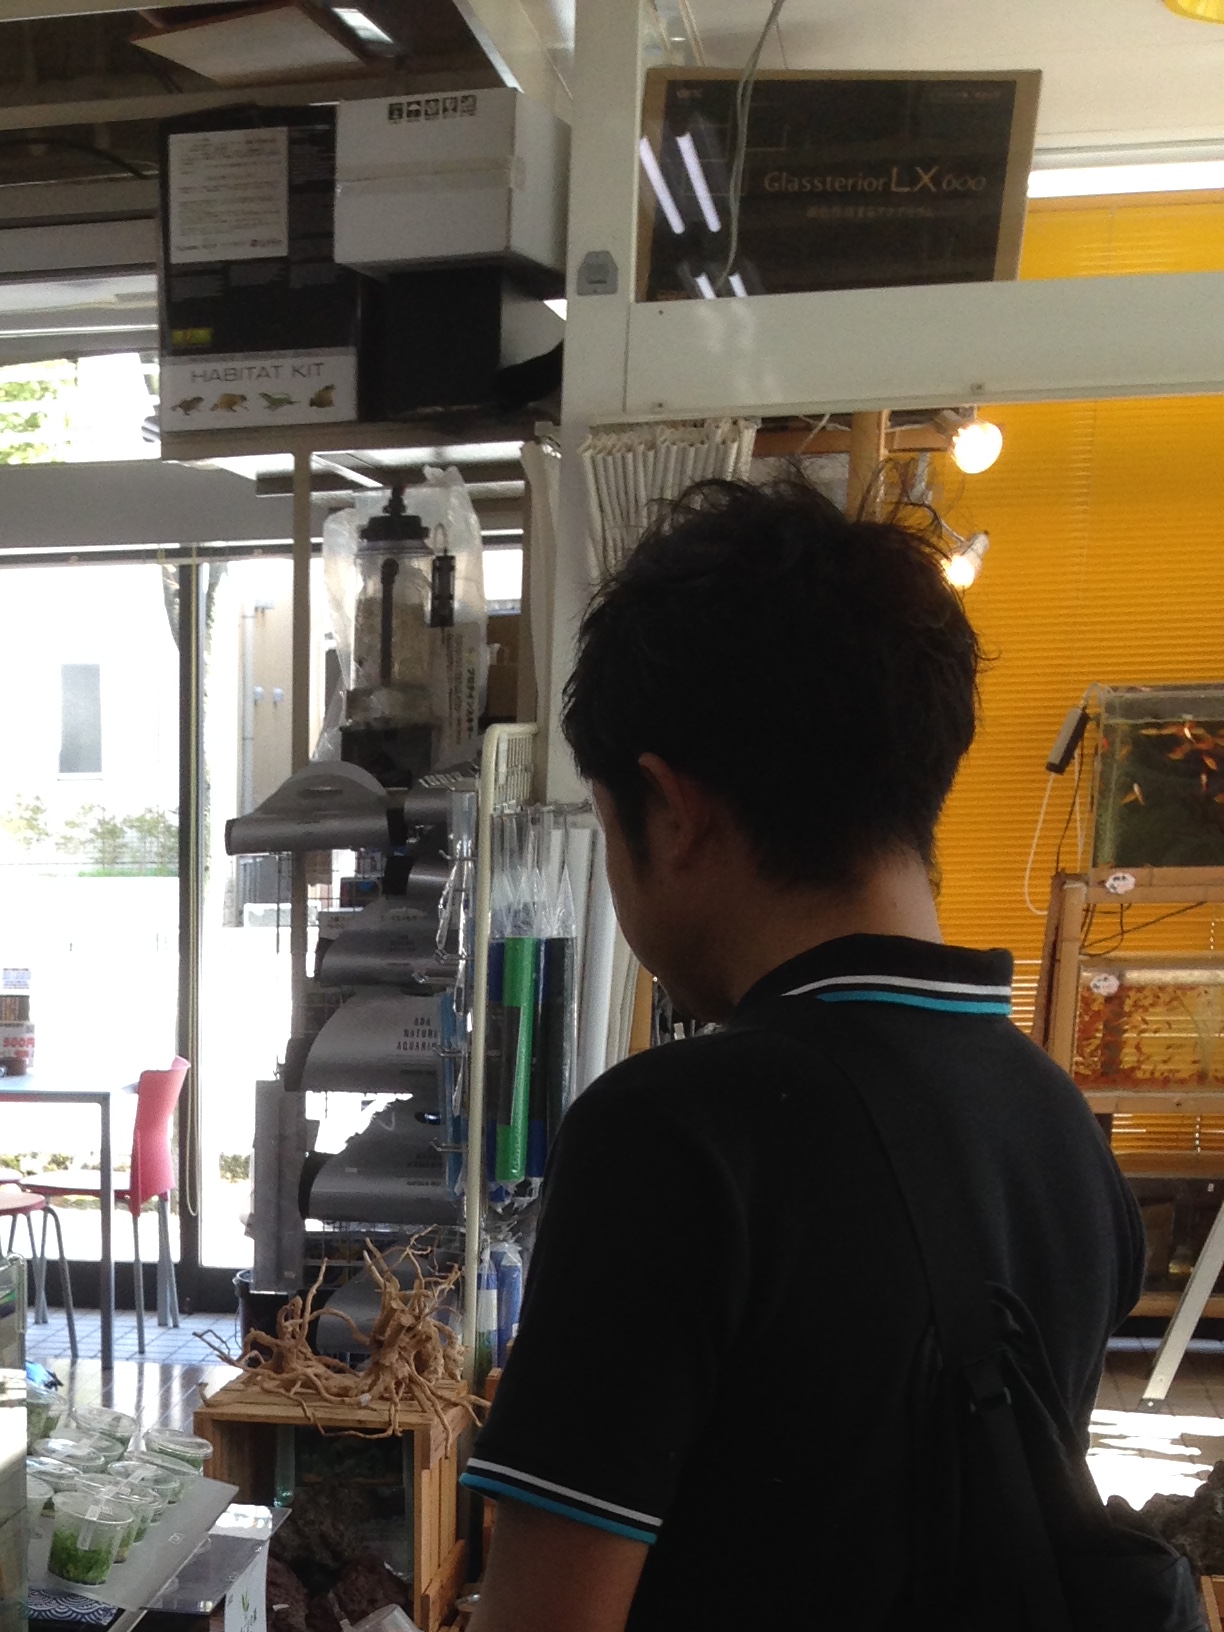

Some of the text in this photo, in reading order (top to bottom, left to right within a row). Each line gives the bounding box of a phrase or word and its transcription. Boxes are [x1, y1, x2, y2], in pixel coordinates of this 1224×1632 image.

[763, 171, 888, 193] Glassterior
[890, 165, 940, 193] LX
[190, 361, 325, 383] HABITAT KIT
